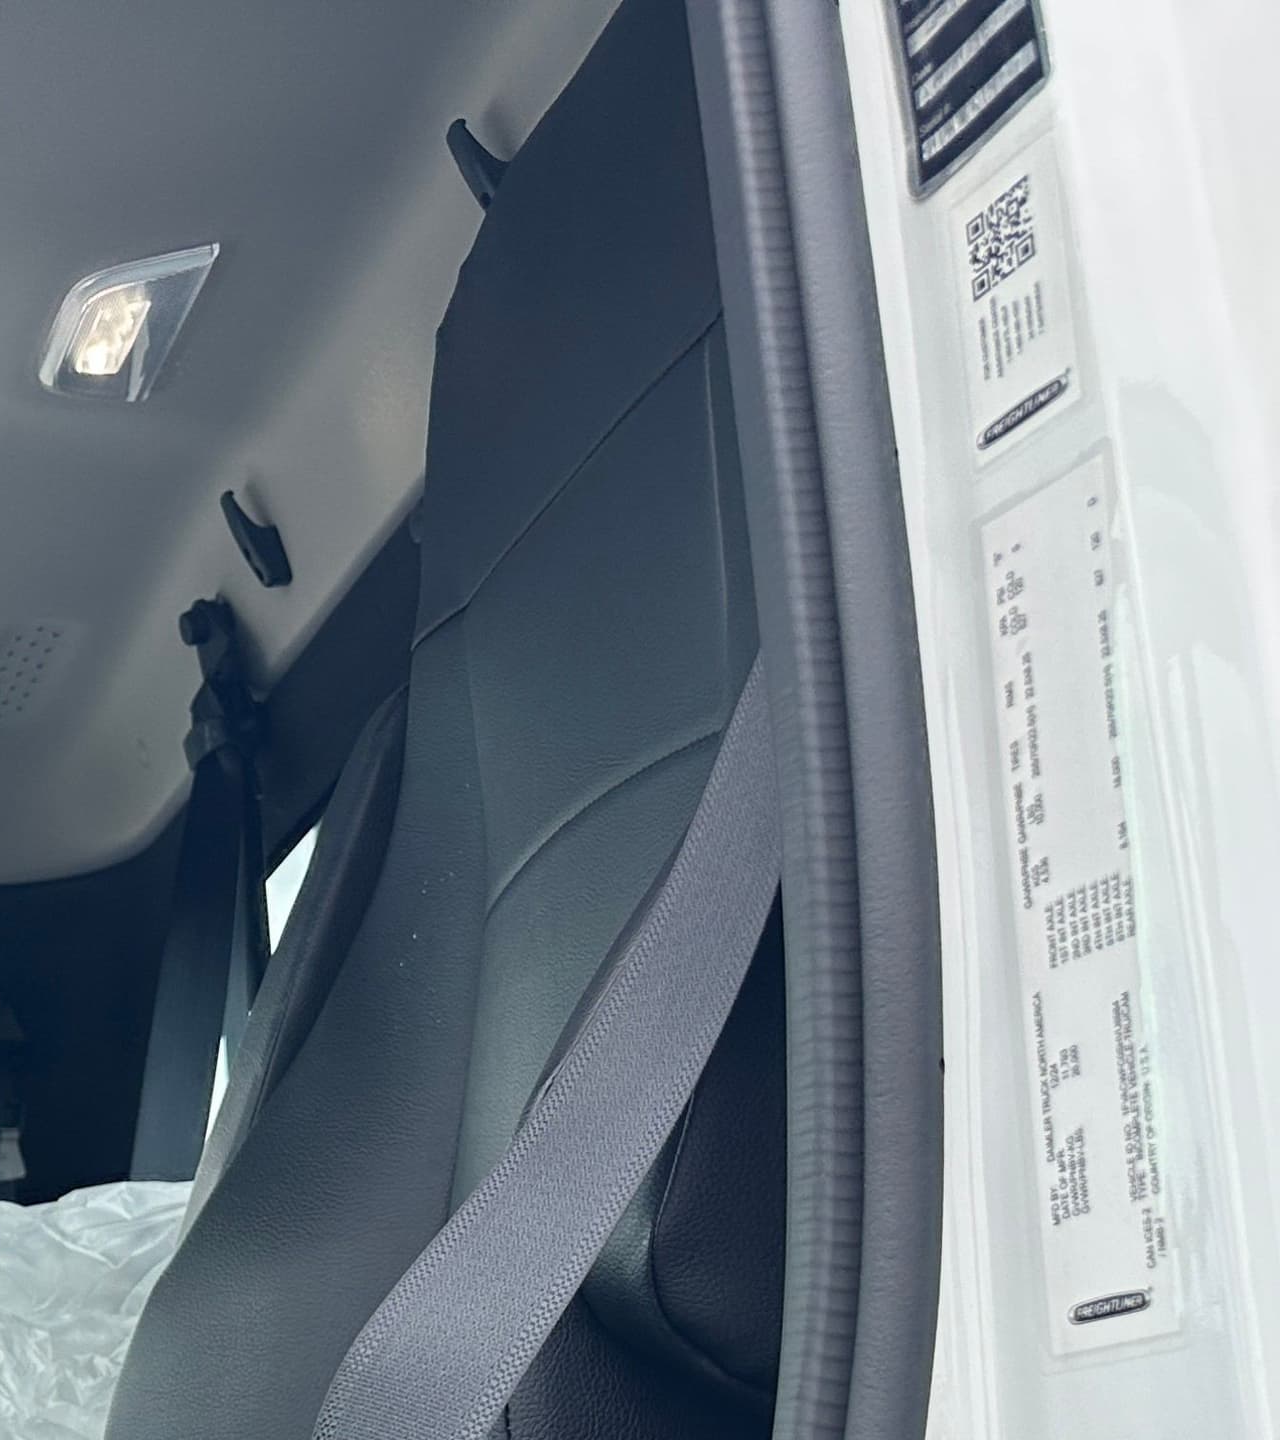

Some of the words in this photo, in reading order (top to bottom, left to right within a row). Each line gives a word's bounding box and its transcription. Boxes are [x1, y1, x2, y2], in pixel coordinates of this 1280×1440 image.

[986, 381, 1060, 443] FREIGHTLINER
[1046, 932, 1058, 969] FRONT
[1032, 990, 1044, 1039] AMERICA
[1036, 1039, 1047, 1078] NORTH
[1039, 1077, 1050, 1115] TRUCK
[1043, 1115, 1055, 1162] DAIMLER
[1145, 1123, 1155, 1140] OF
[1058, 1174, 1067, 1190] OF
[1146, 1141, 1160, 1195] COUNTRY
[1060, 1191, 1070, 1219] DATE
[1074, 1293, 1144, 1319] FREIGHTLINER
